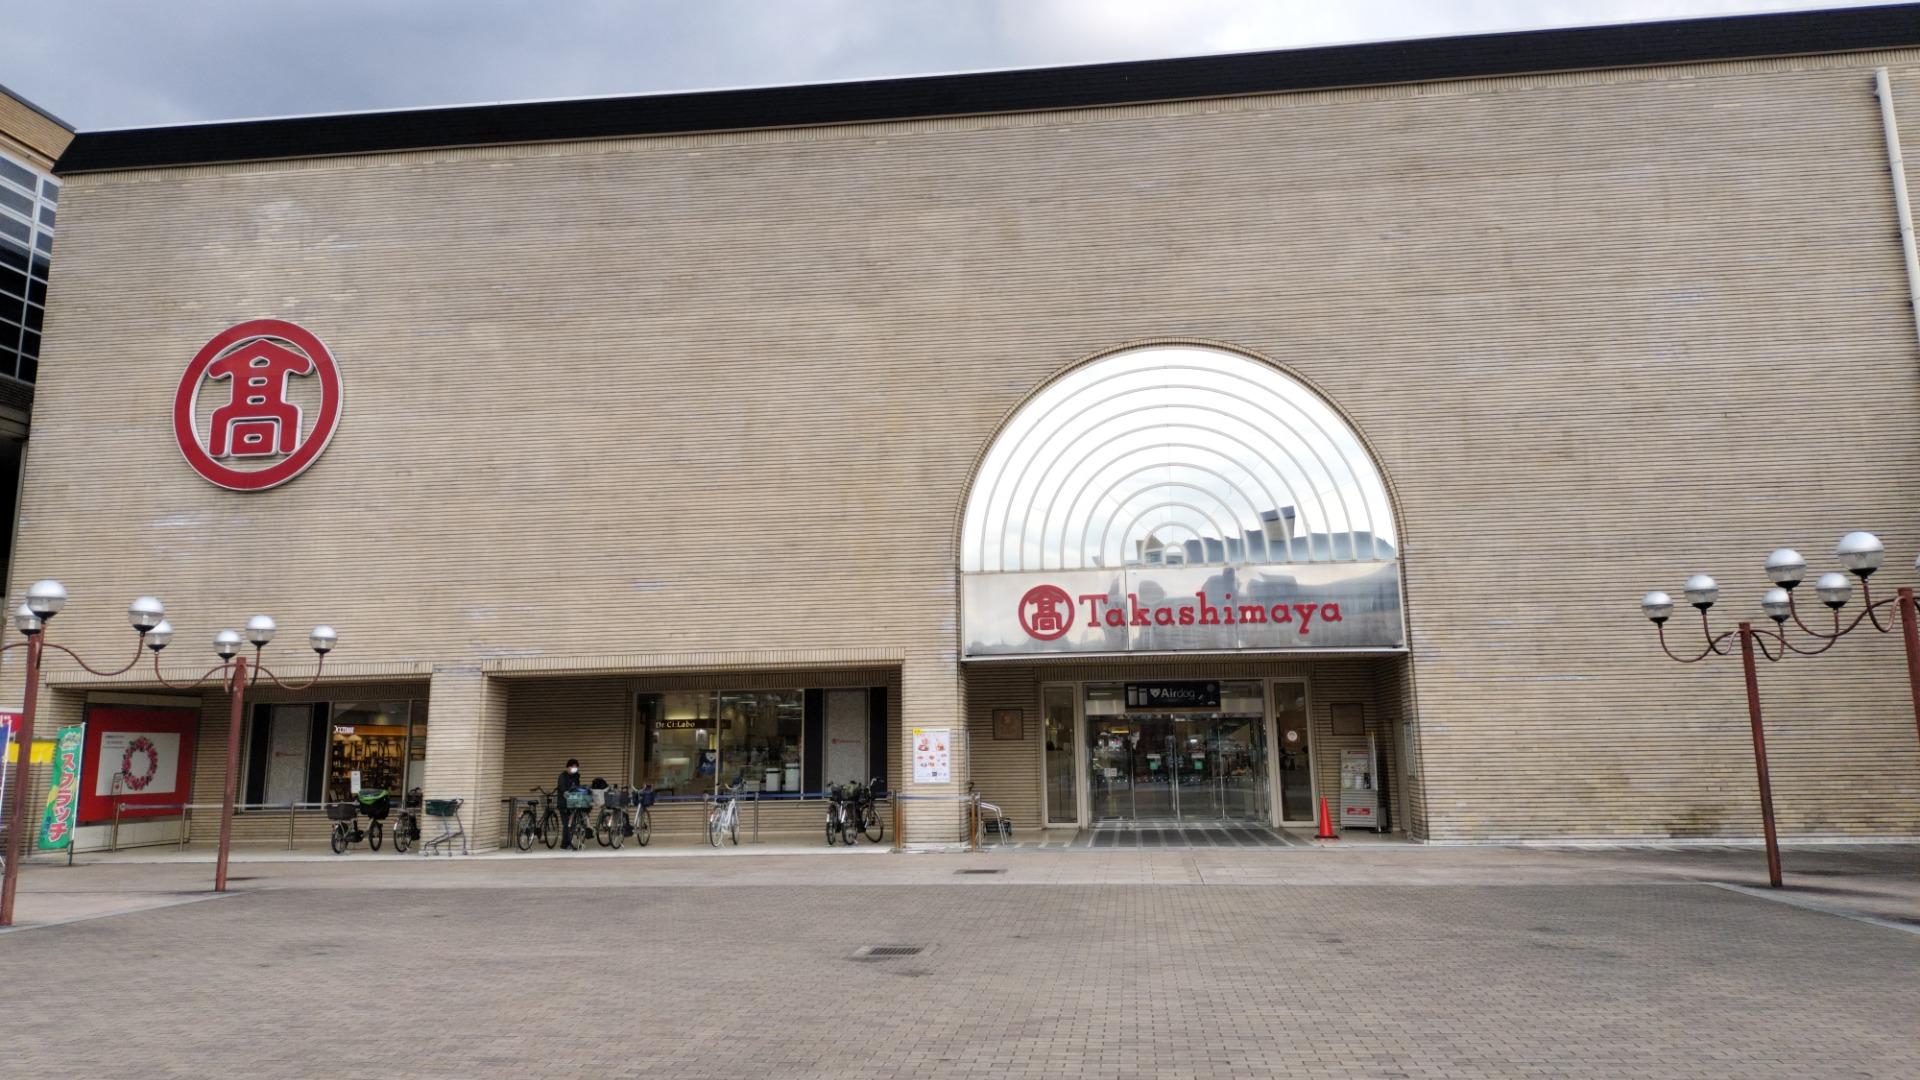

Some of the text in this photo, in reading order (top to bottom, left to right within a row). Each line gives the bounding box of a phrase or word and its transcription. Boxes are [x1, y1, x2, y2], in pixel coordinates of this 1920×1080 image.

[1078, 591, 1342, 633] Takashimaya
[1161, 688, 1195, 700] Airdog
[48, 753, 75, 841] スクラッチ
